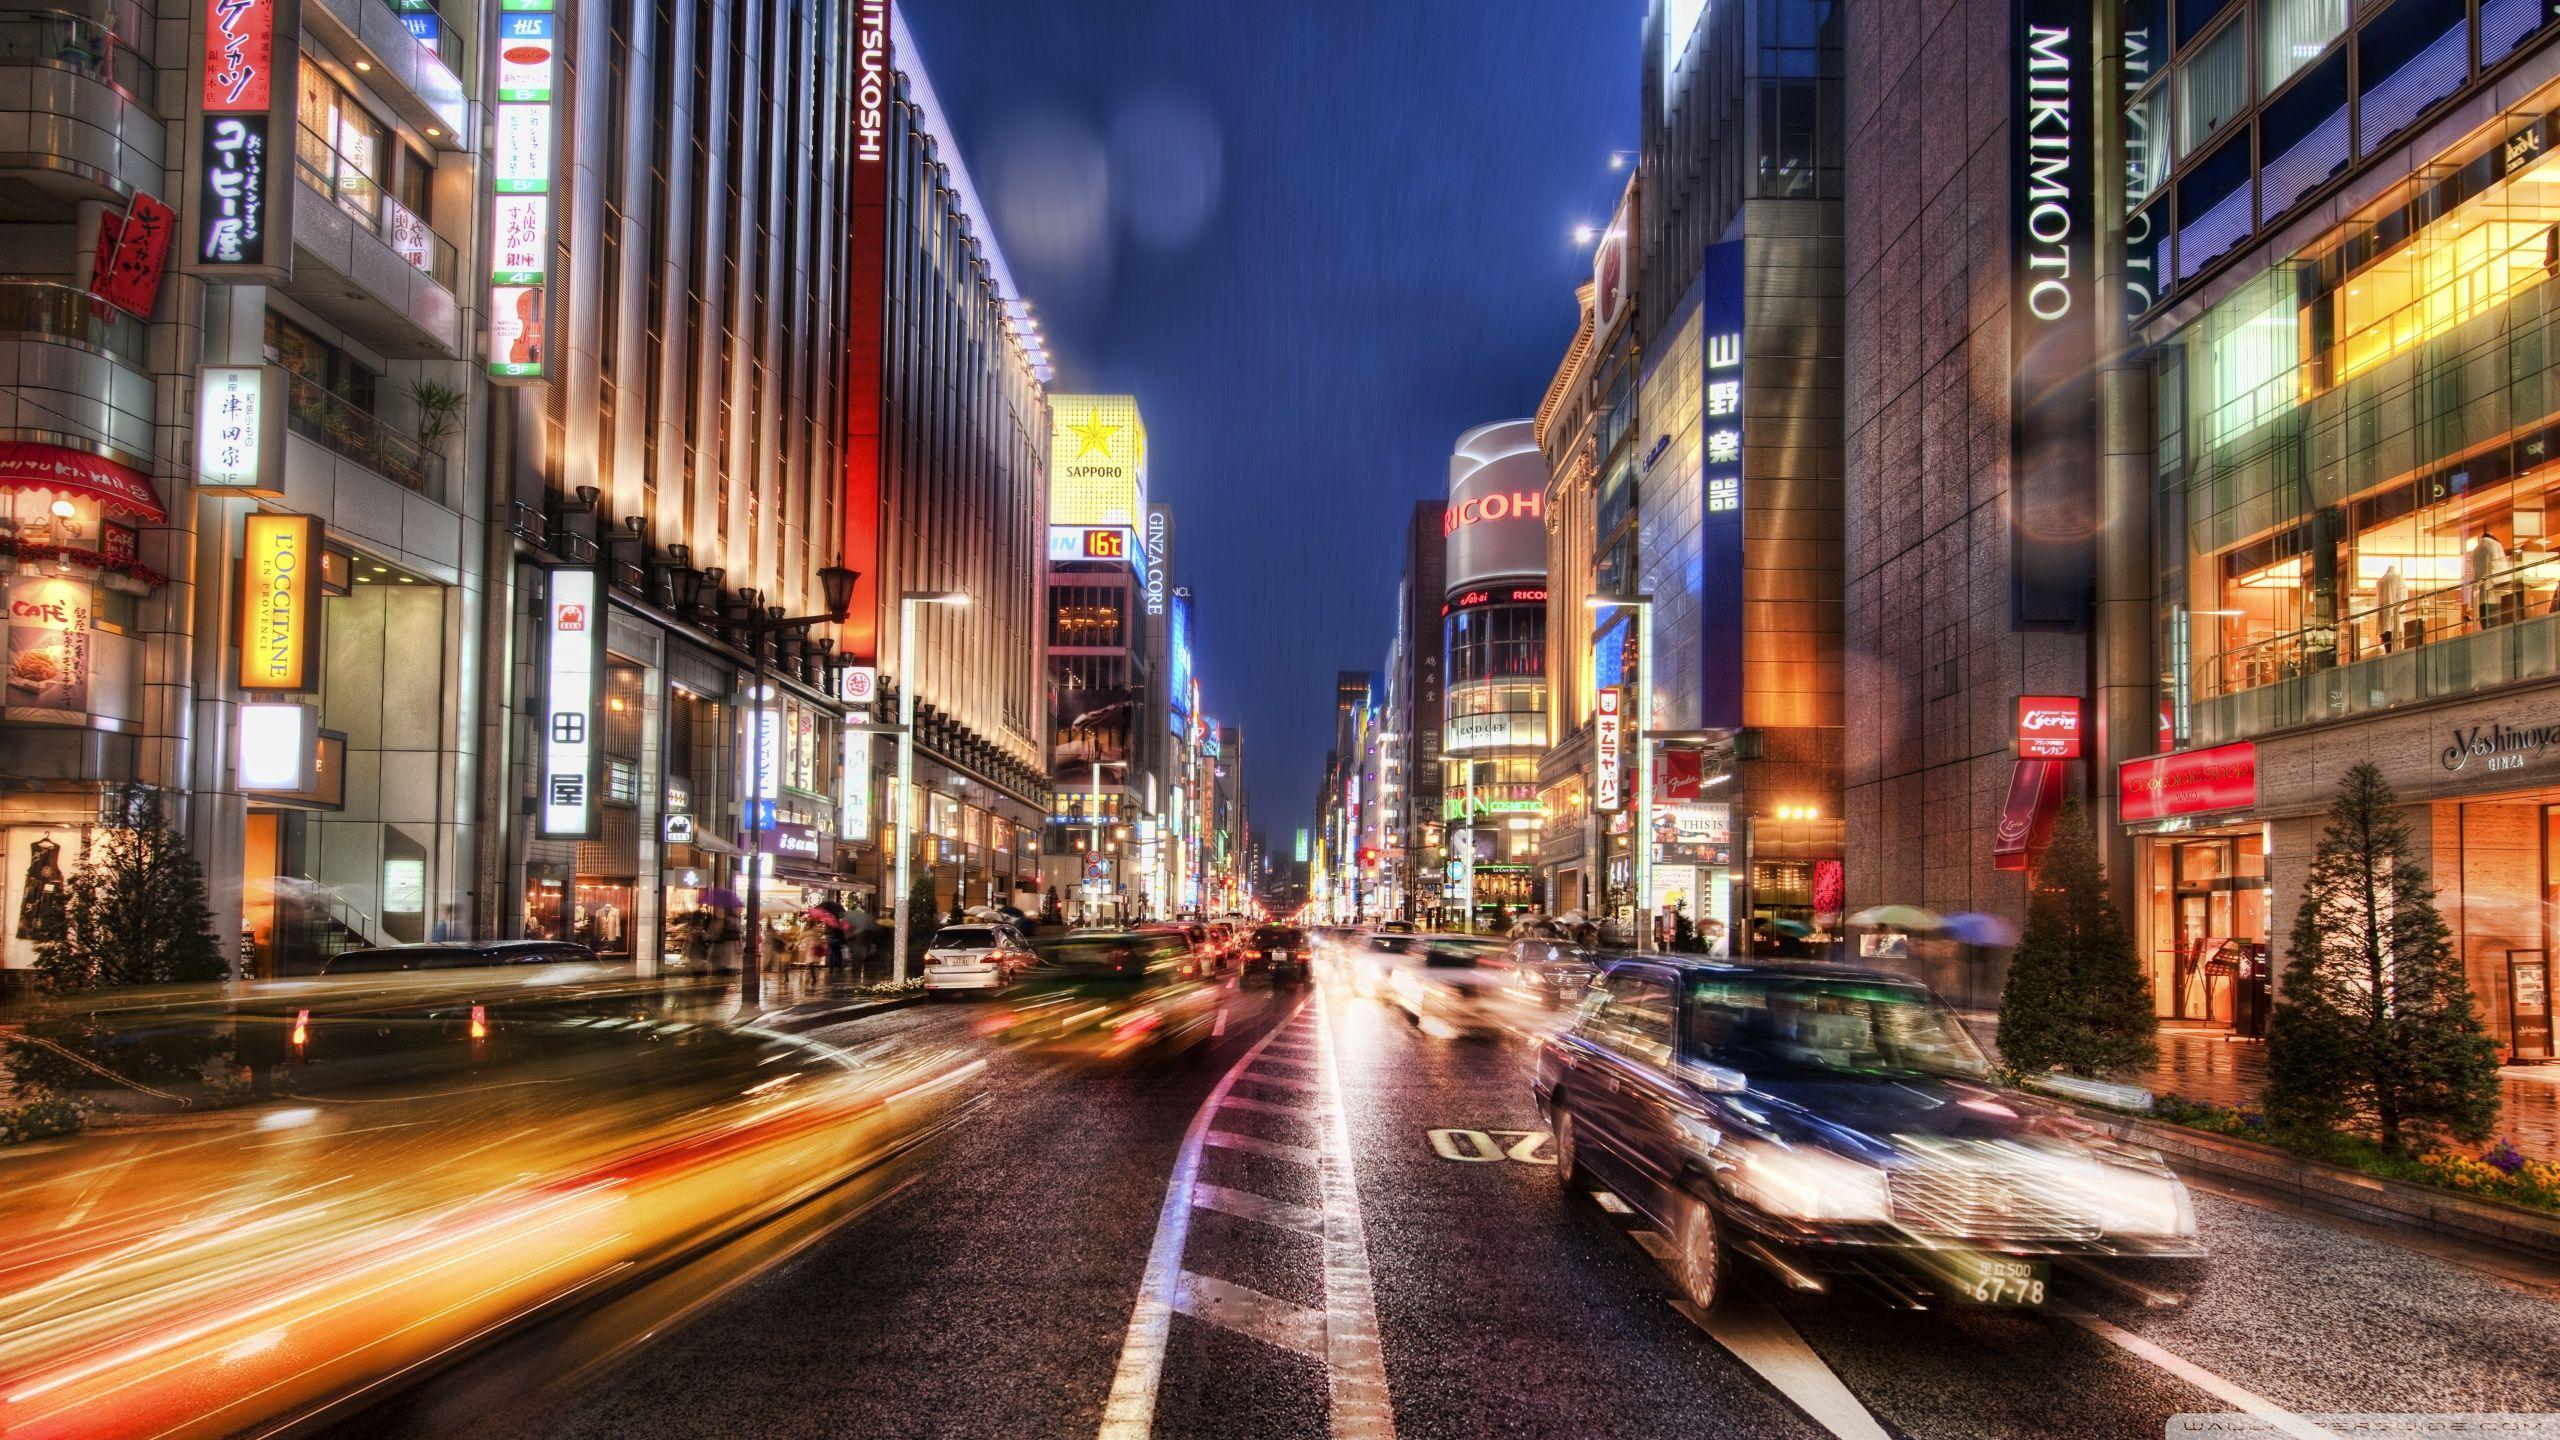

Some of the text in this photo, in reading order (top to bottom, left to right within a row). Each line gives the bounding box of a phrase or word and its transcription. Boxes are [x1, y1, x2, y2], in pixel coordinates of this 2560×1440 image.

[860, 0, 884, 160] ITSUKOSHI
[206, 120, 246, 261] コーヒー屋
[2029, 24, 2071, 321] MIKIMOTO
[510, 272, 532, 282] 4F
[506, 365, 528, 375] 3F
[1709, 333, 1740, 512] 山野楽器
[1066, 466, 1122, 478] SAPPORO
[1443, 491, 1541, 538] RICOH
[1147, 512, 1164, 615] GINZA CORE
[270, 534, 296, 678] L'OCCITANE
[1457, 726, 1482, 736] RAND
[550, 711, 585, 807] 田屋
[1601, 721, 1617, 804] キムラヤのパン
[2488, 755, 2524, 771] GINZA
[1682, 820, 1723, 830] THIS IS
[1975, 1277, 2044, 1304] 67-78
[2007, 1264, 2031, 1278] 500
